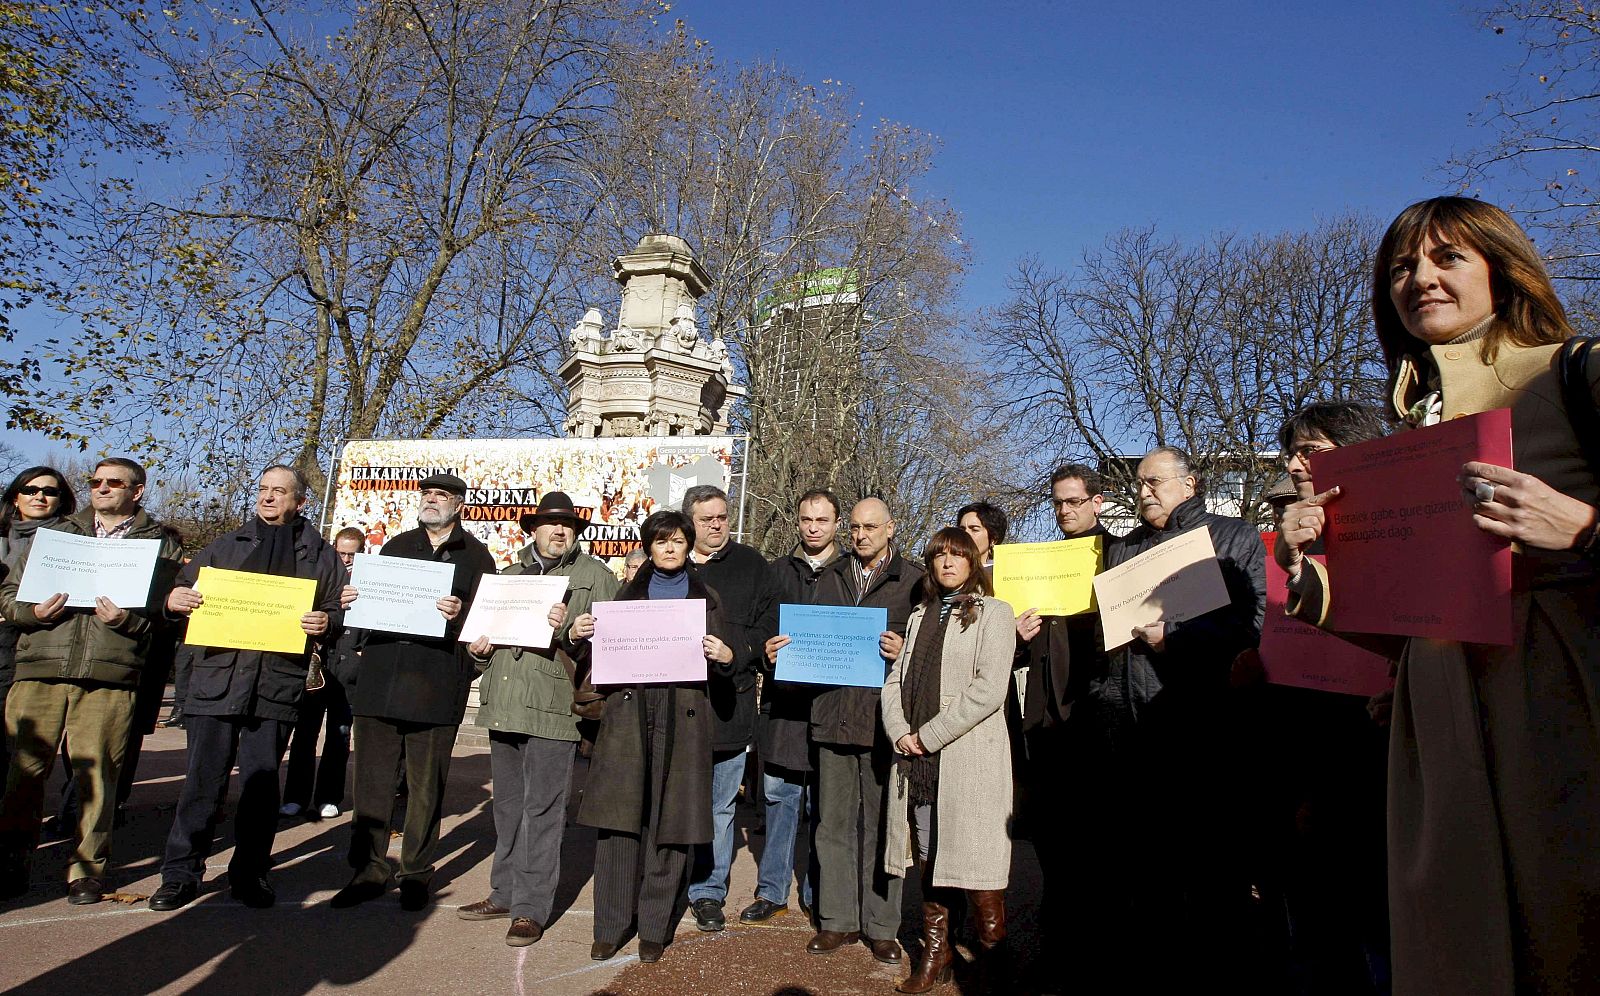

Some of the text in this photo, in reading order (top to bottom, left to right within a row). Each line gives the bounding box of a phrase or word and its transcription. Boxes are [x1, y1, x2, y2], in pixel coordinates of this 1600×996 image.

[350, 480, 421, 490] SOLIDARI
[464, 489, 536, 504] ESPENA
[1334, 512, 1368, 525] Beraiek
[1400, 504, 1422, 521] gure
[1337, 526, 1386, 543] osatugabe
[42, 554, 70, 564] Aquella
[368, 580, 401, 589] convirtieron
[205, 594, 228, 602] Beraiek
[230, 598, 266, 607] dagoeneko
[250, 608, 280, 616] geuregan
